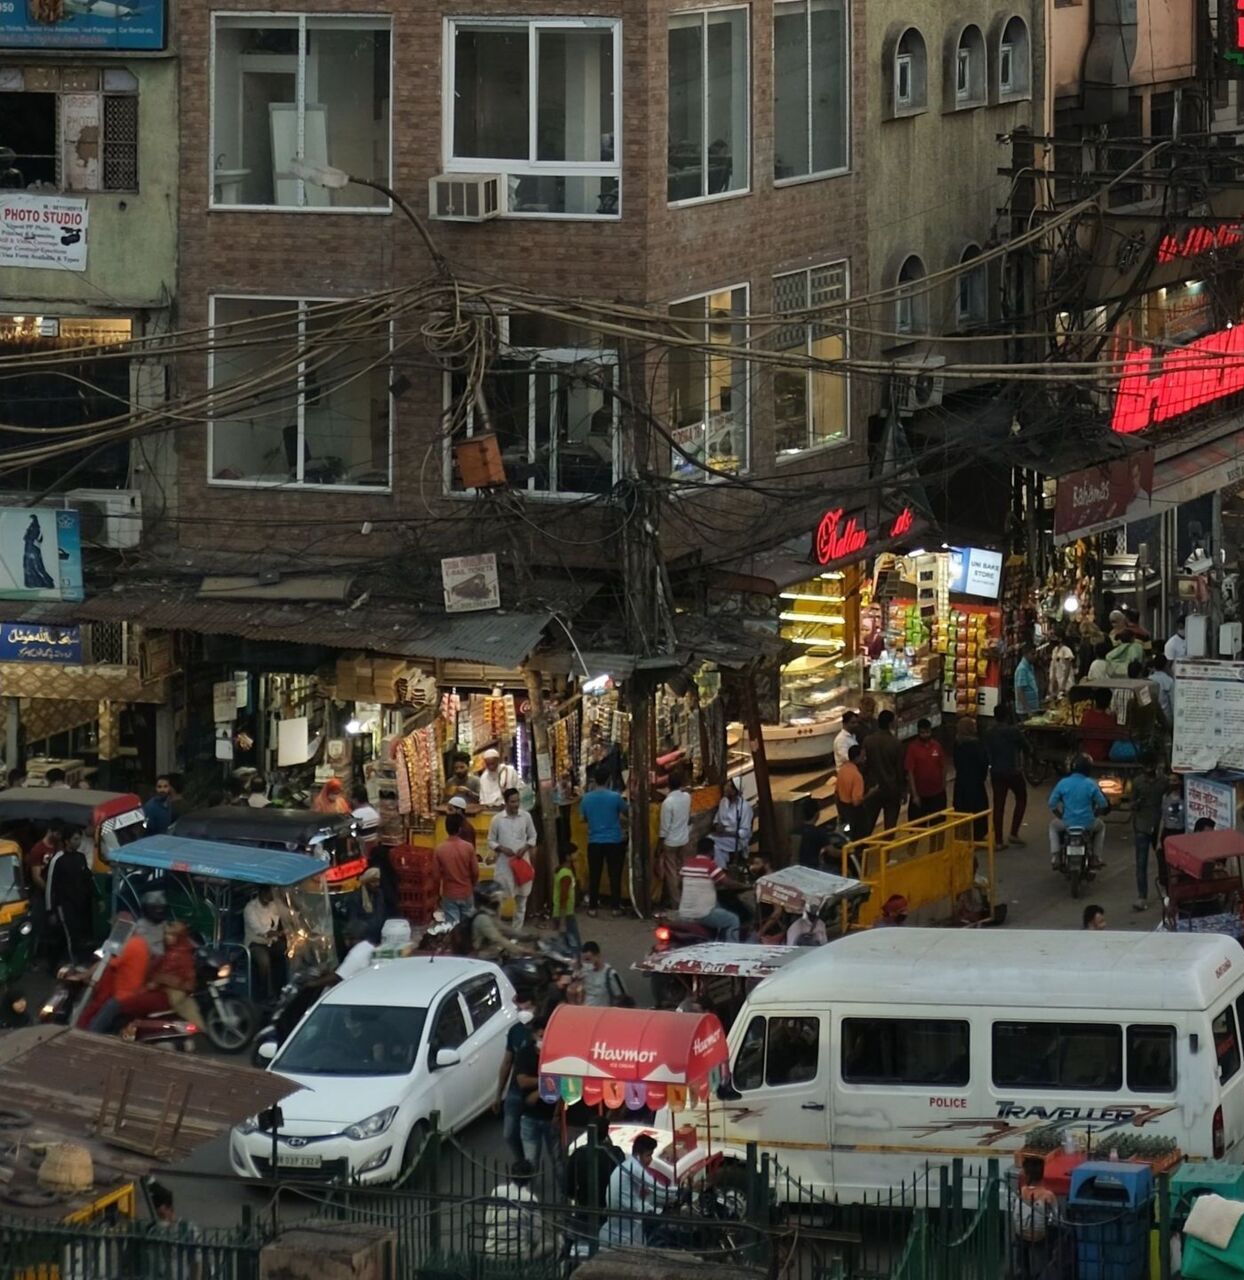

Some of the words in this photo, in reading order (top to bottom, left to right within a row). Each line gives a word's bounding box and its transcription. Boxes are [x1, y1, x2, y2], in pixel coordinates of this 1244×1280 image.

[4, 208, 40, 222] PHOTO
[43, 211, 83, 225] STUDIO
[590, 1041, 658, 1063] Havmor
[929, 1097, 967, 1109] POLICE
[995, 1100, 1136, 1122] TRAVELLER
